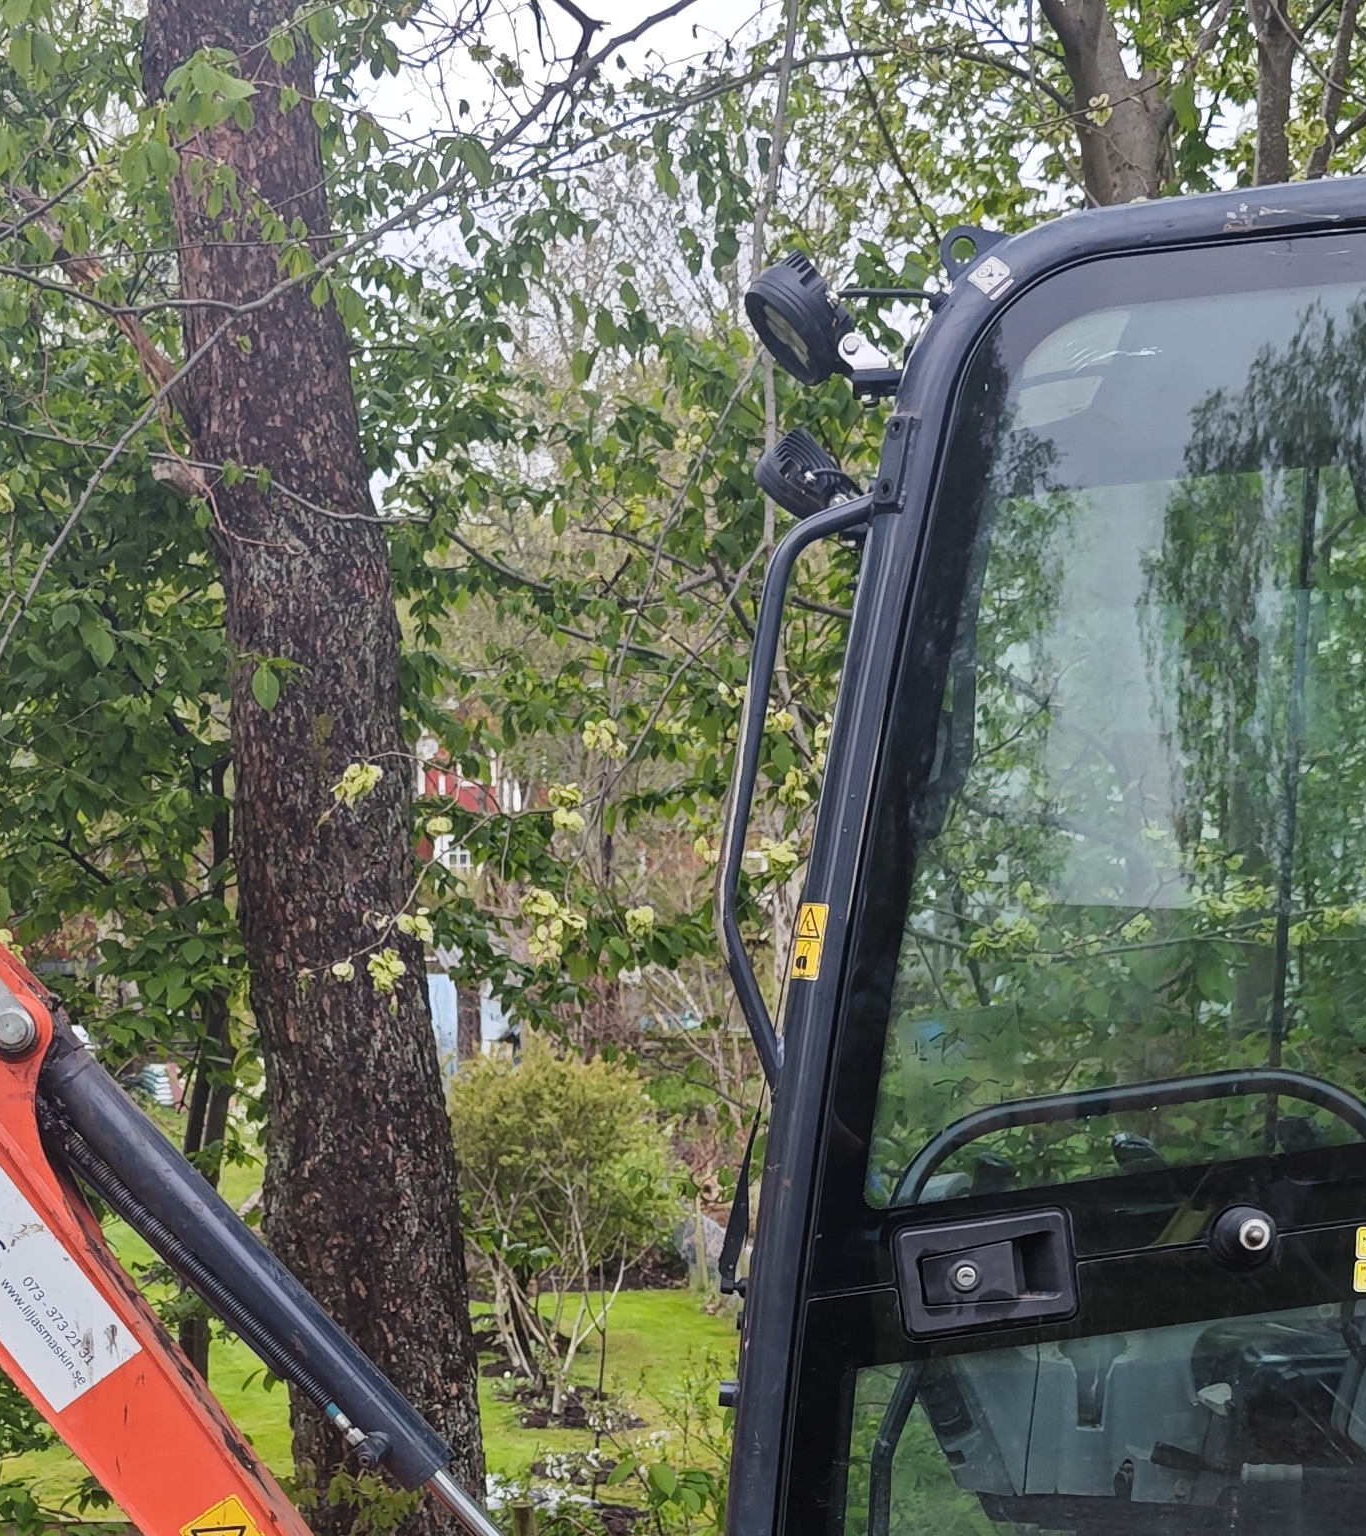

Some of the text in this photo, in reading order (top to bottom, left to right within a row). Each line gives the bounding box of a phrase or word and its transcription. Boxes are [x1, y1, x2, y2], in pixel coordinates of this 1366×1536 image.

[0, 1277, 86, 1386] www.liljasmaskinse
[22, 1276, 45, 1301] 073
[46, 1305, 69, 1332] 373
[65, 1331, 82, 1349] 21
[79, 1347, 95, 1366] 31
